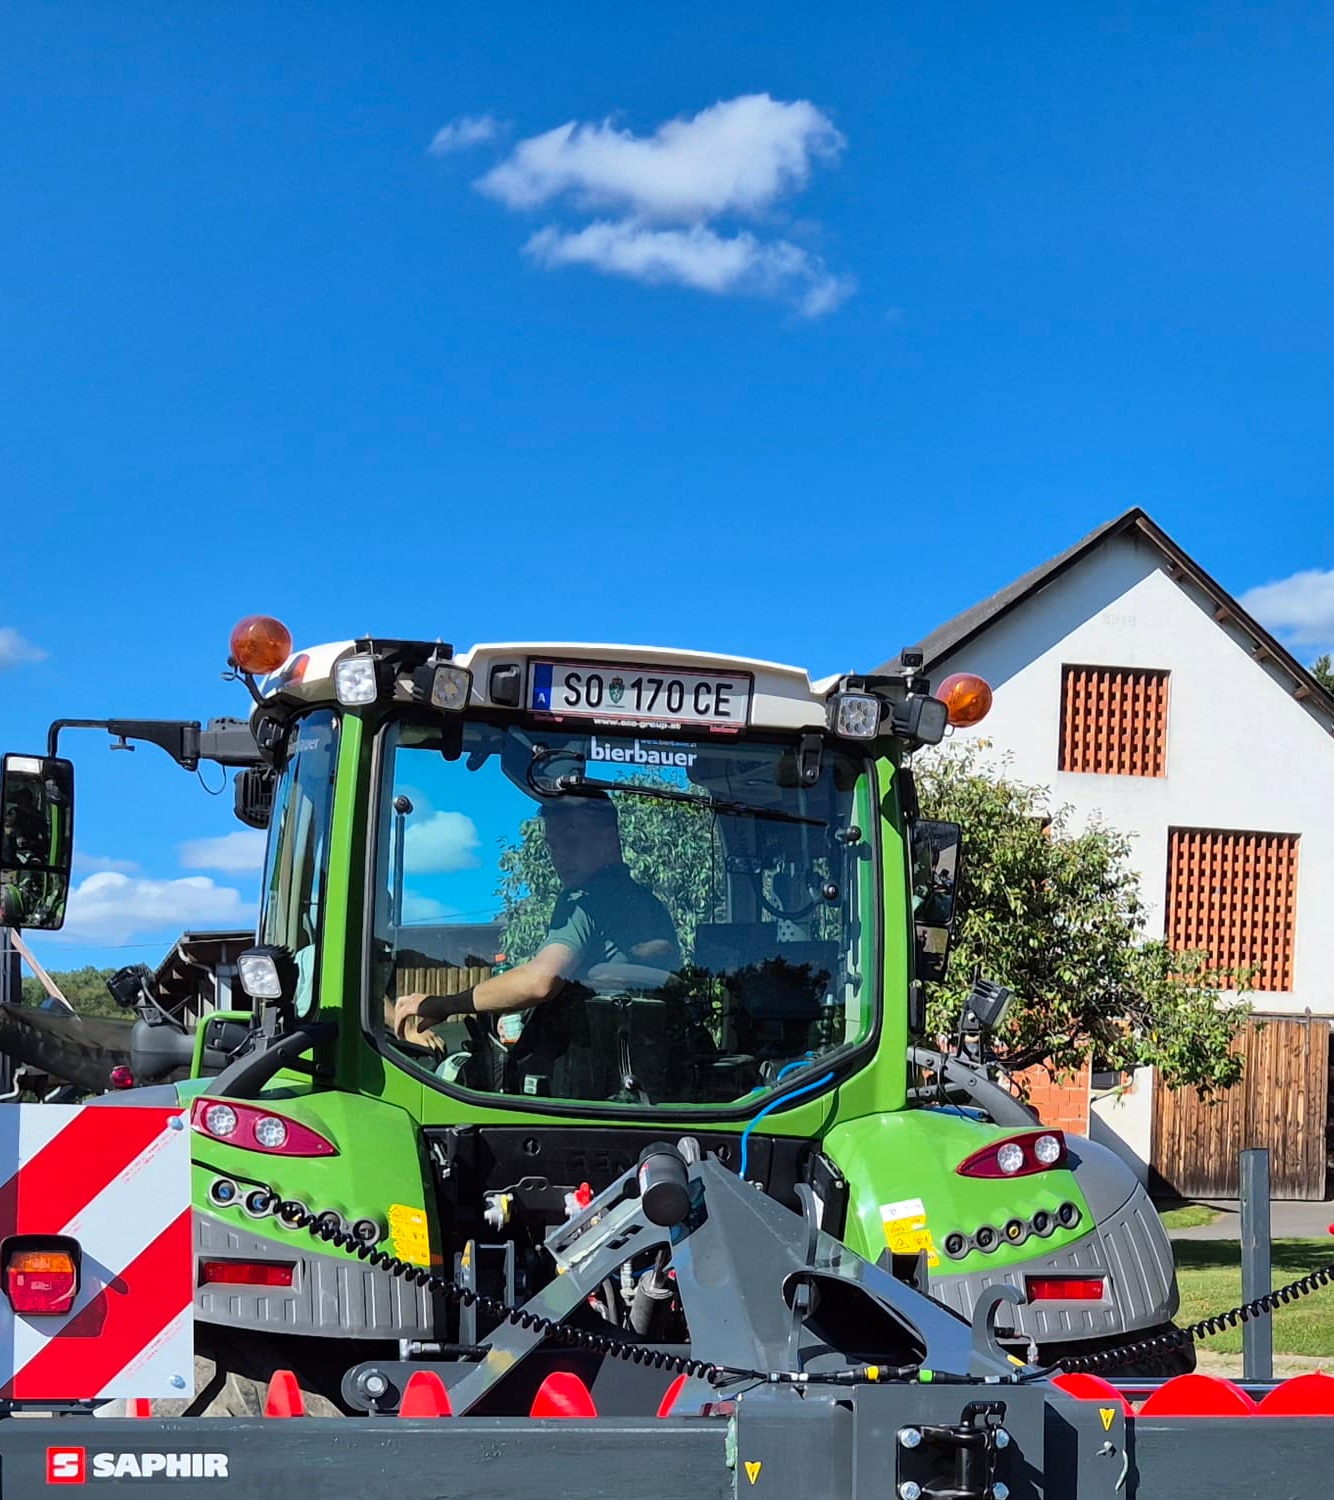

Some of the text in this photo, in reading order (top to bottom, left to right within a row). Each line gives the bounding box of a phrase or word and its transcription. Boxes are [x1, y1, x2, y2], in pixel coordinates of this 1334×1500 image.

[564, 672, 733, 716] SO 170 CE
[591, 735, 697, 767] bierbauer
[93, 1453, 229, 1477] SAPHIR
